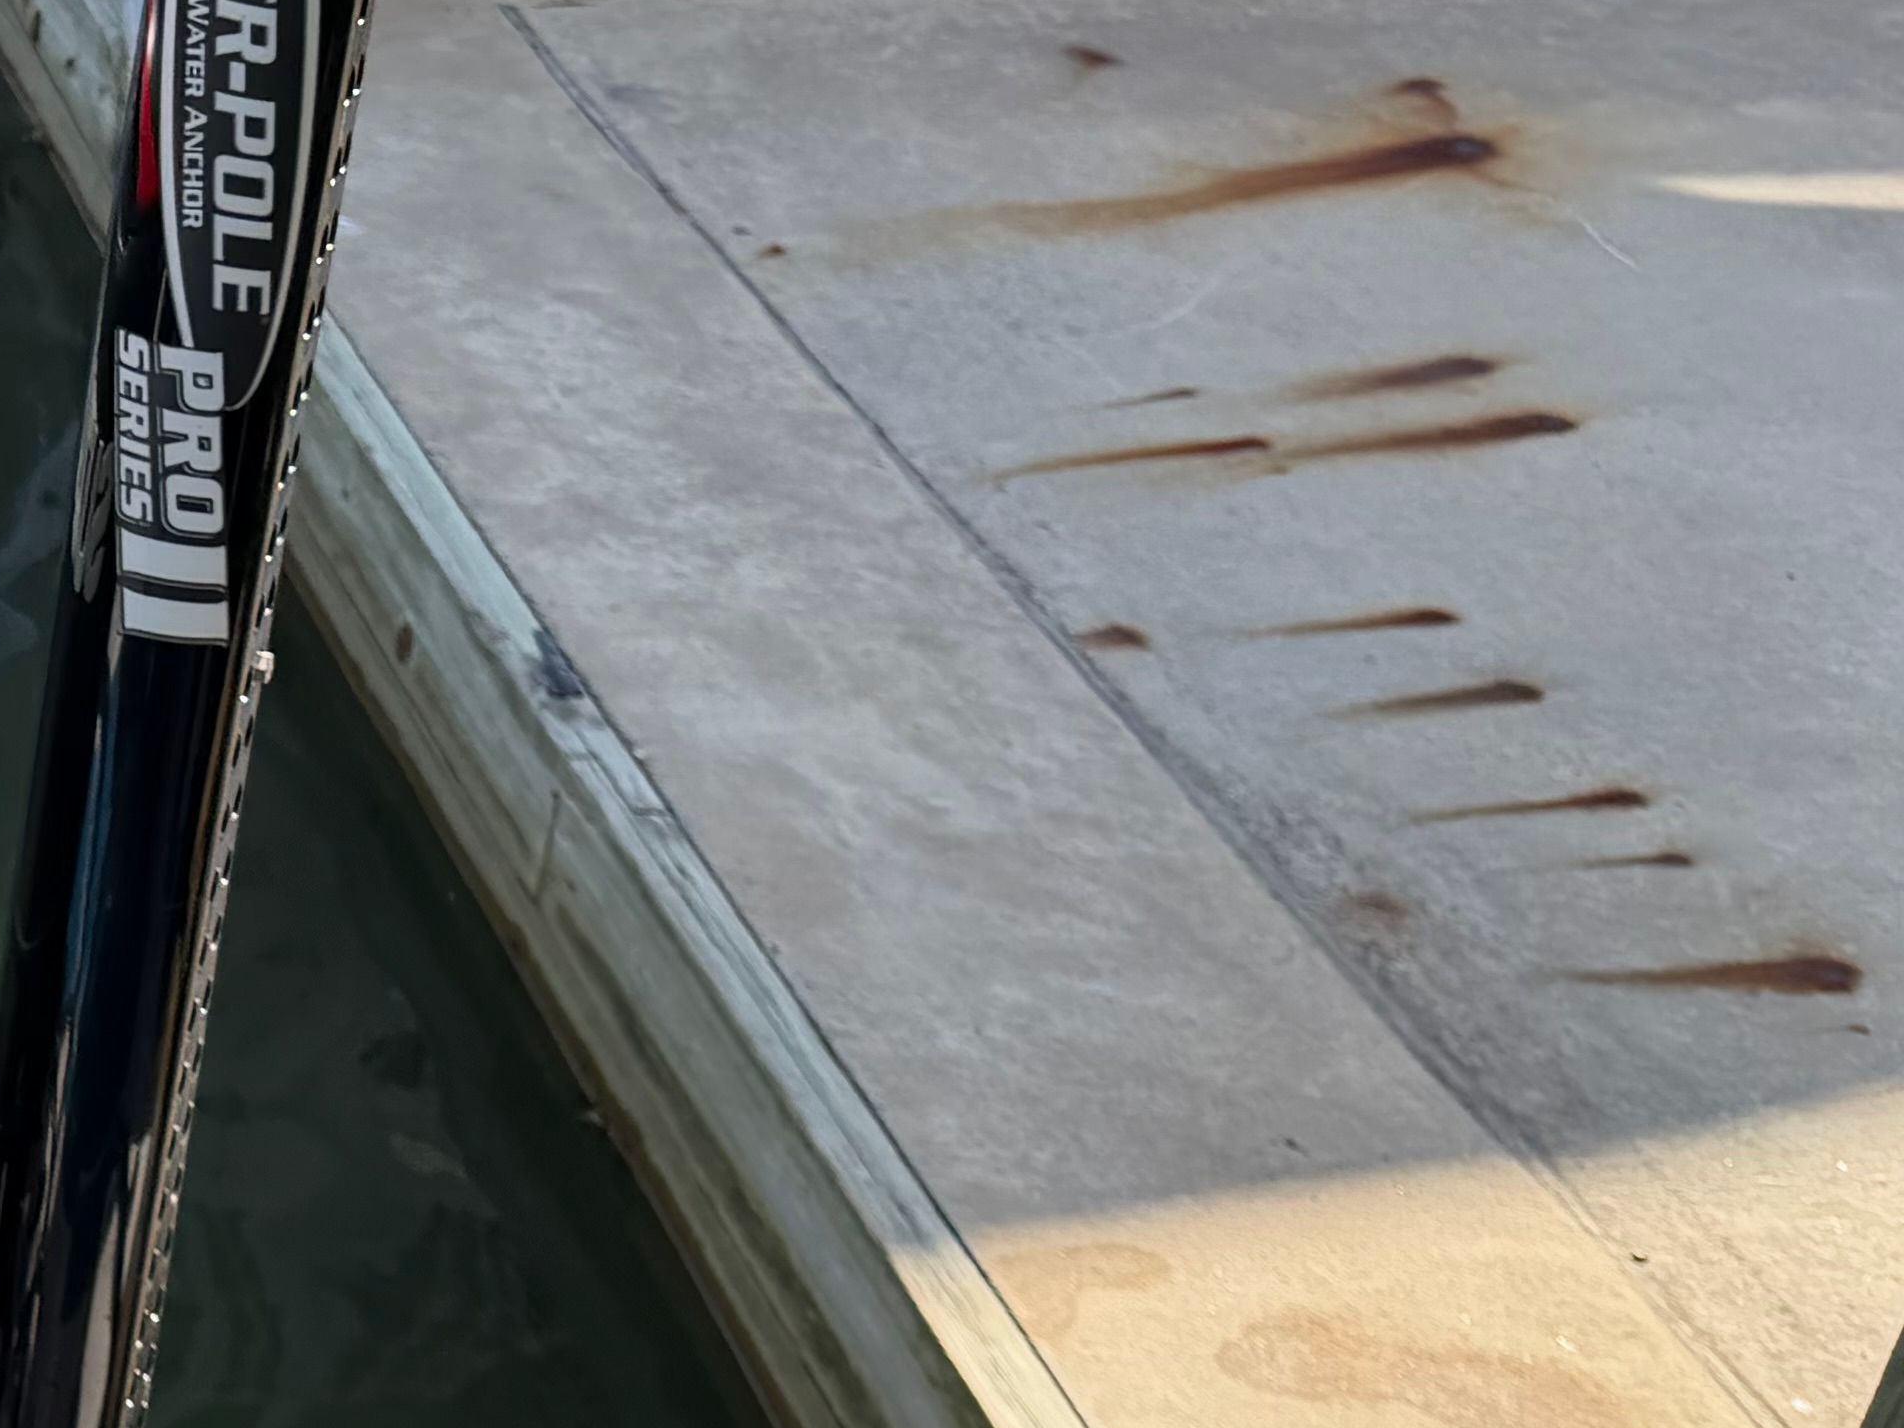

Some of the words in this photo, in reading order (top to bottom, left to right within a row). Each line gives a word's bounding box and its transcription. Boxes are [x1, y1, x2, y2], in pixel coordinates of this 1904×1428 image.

[180, 105, 205, 230] ANCHOR
[117, 329, 154, 527] SERIES
[157, 343, 226, 539] PRO
